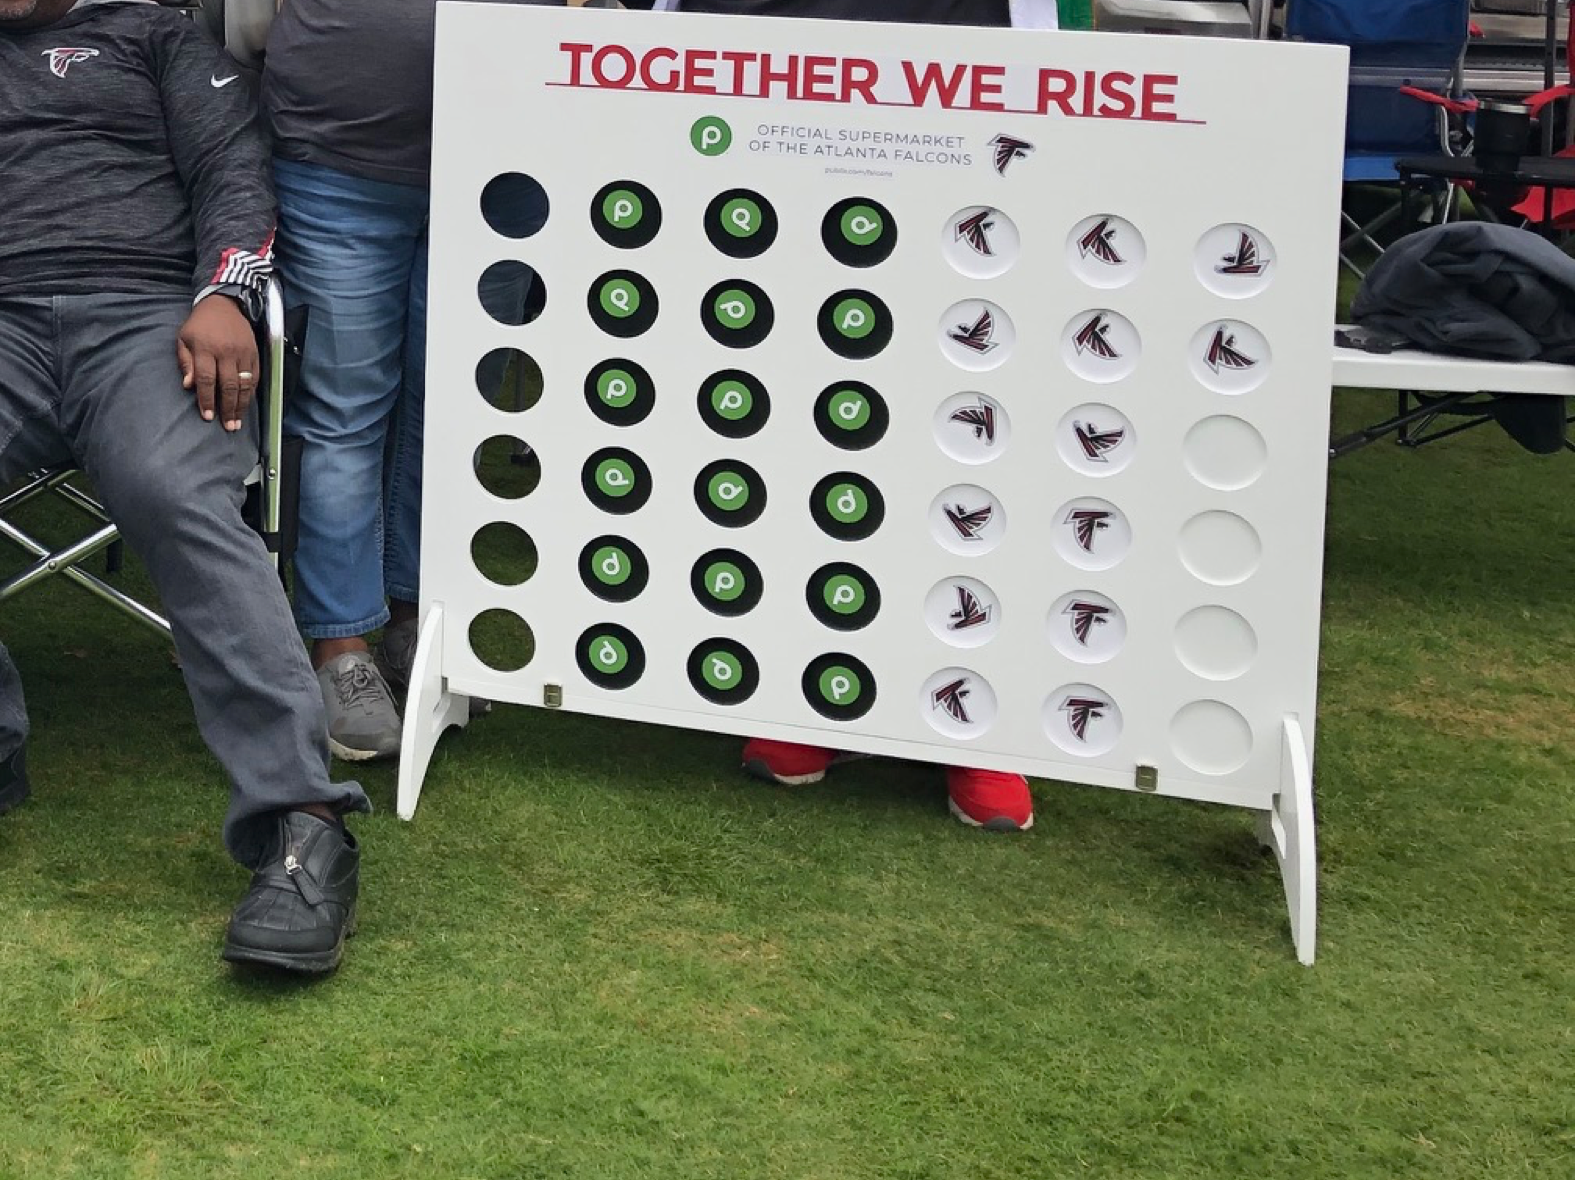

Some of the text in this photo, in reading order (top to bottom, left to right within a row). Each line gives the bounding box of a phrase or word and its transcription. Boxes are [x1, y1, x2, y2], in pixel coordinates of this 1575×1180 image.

[559, 42, 1178, 121] TOGETHER WE RISE
[757, 124, 965, 149] OFFICIAL SUPERMARKET
[749, 139, 973, 166] OF THE ATLANTA FALCONS
